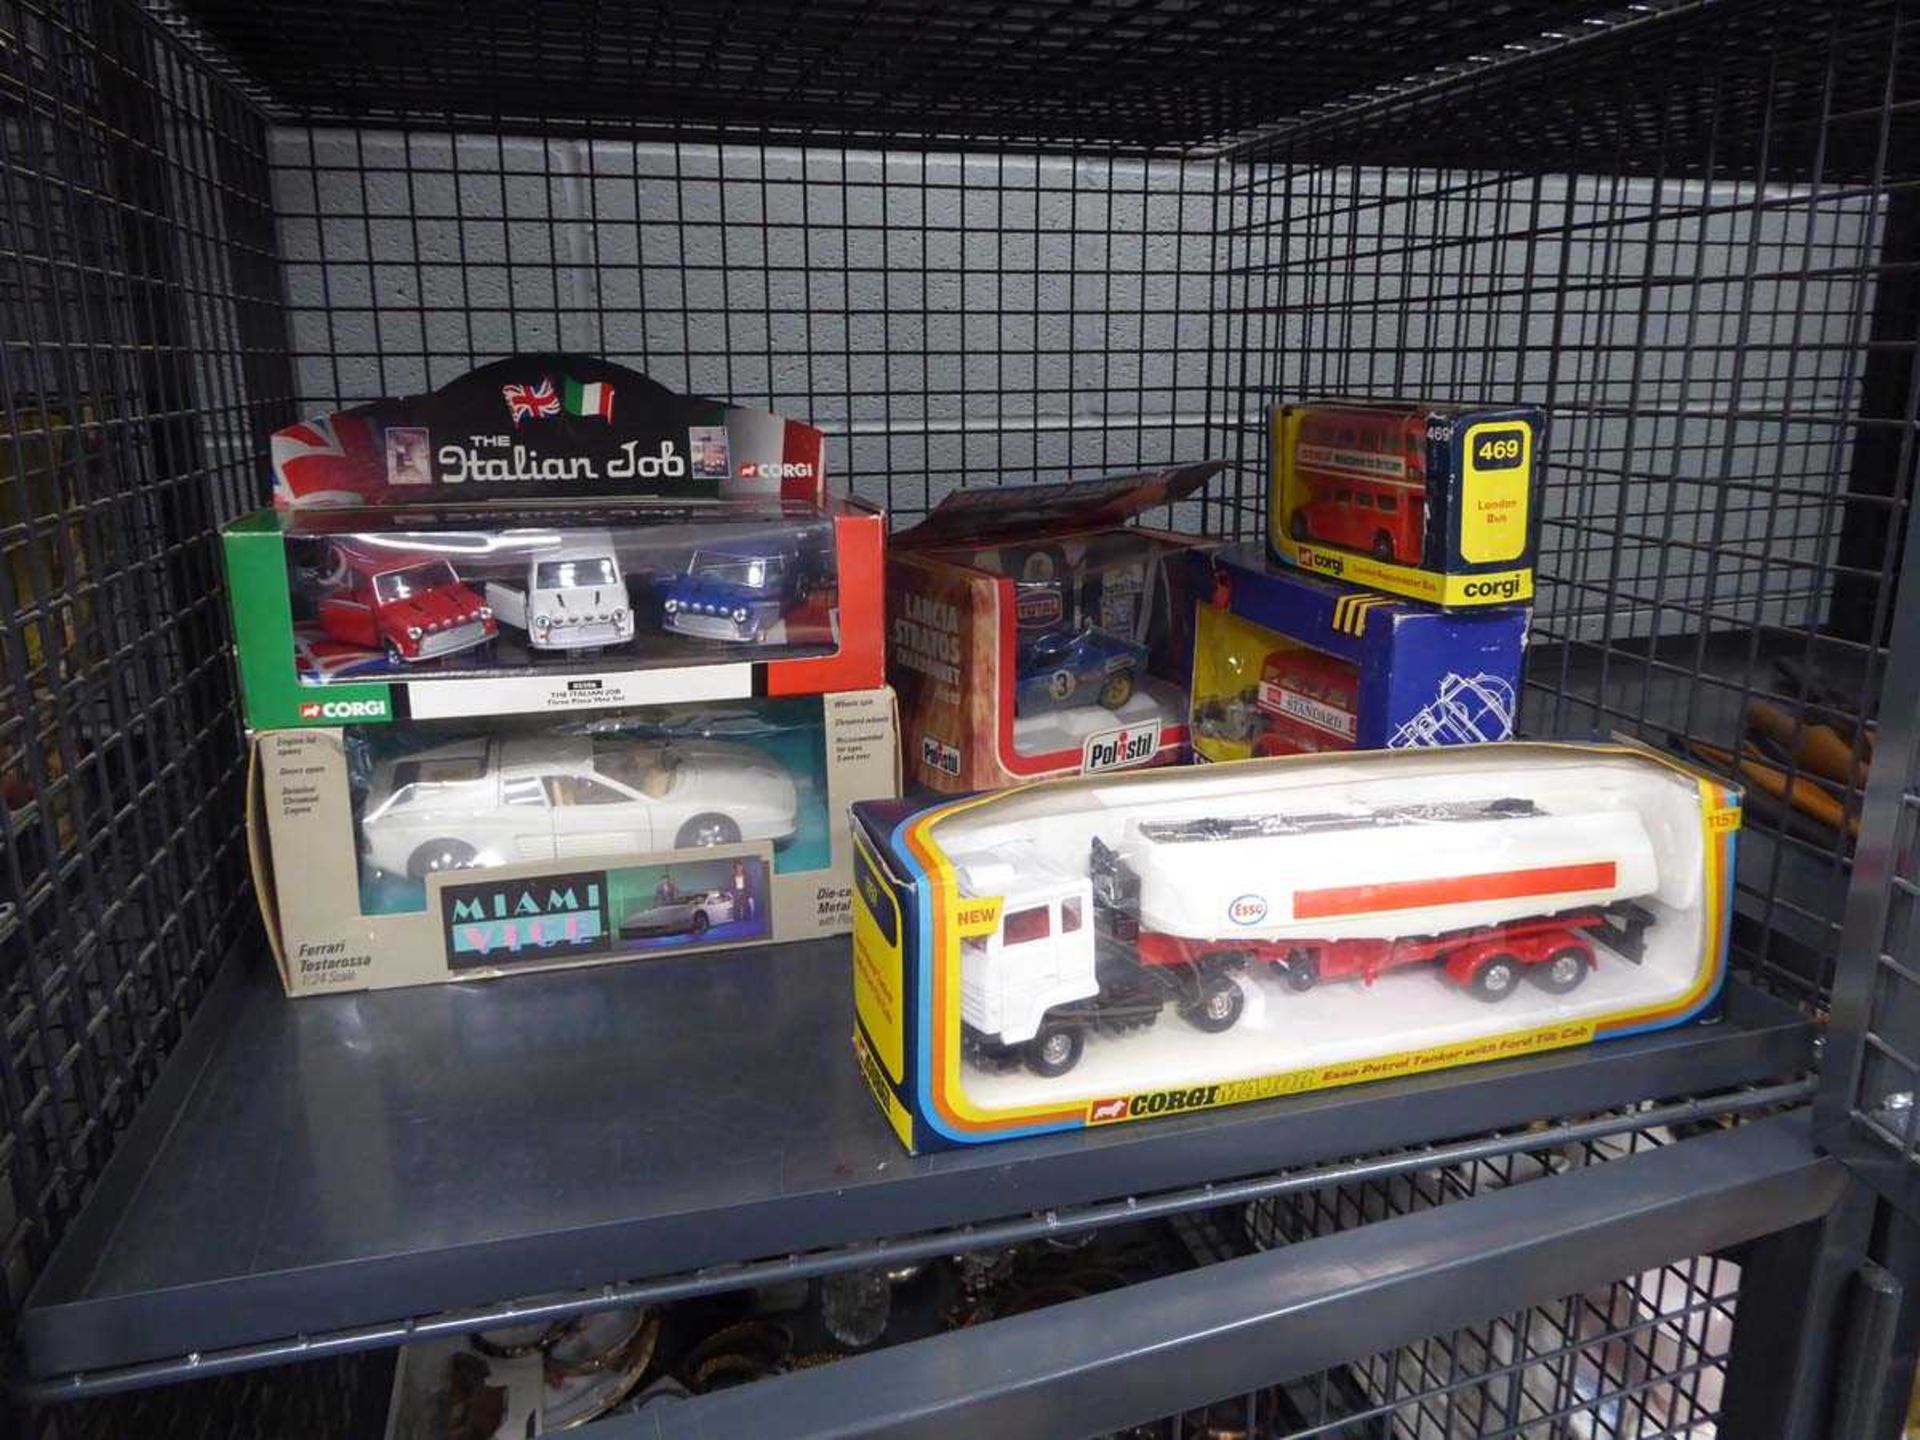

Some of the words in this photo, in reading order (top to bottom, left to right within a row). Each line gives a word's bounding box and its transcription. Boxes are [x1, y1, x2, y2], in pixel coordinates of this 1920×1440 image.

[469, 435, 512, 447] THE
[1426, 426, 1449, 441] 469
[438, 445, 600, 483] Italian
[607, 440, 686, 478] Job
[1478, 439, 1519, 461] 469
[757, 462, 814, 478] CORGI
[1477, 498, 1518, 512] London
[1485, 513, 1508, 524] Bus
[1314, 553, 1344, 576] corgi
[1463, 574, 1521, 598] corgi
[905, 592, 959, 635] LANCIA
[895, 618, 961, 665] STRATOS
[1055, 672, 1068, 697] 3
[322, 700, 386, 717] CORGI
[1286, 698, 1343, 730] STANDARD
[924, 741, 959, 774] Polistil
[1089, 730, 1153, 769] Polistil
[453, 884, 600, 923] MIAMI
[816, 898, 853, 915] Metal
[957, 907, 997, 927] NEW
[466, 912, 594, 955] VICE
[299, 940, 346, 958] Ferrari
[300, 955, 372, 973] Testarossa
[1130, 1086, 1219, 1116] CORGI
[1322, 1067, 1359, 1081] Esso
[1362, 1057, 1409, 1074] Petrol
[1412, 1050, 1463, 1066] Tanker
[1464, 1043, 1497, 1058] with
[1499, 1036, 1533, 1051] Ford
[1560, 1026, 1588, 1039] Cab
